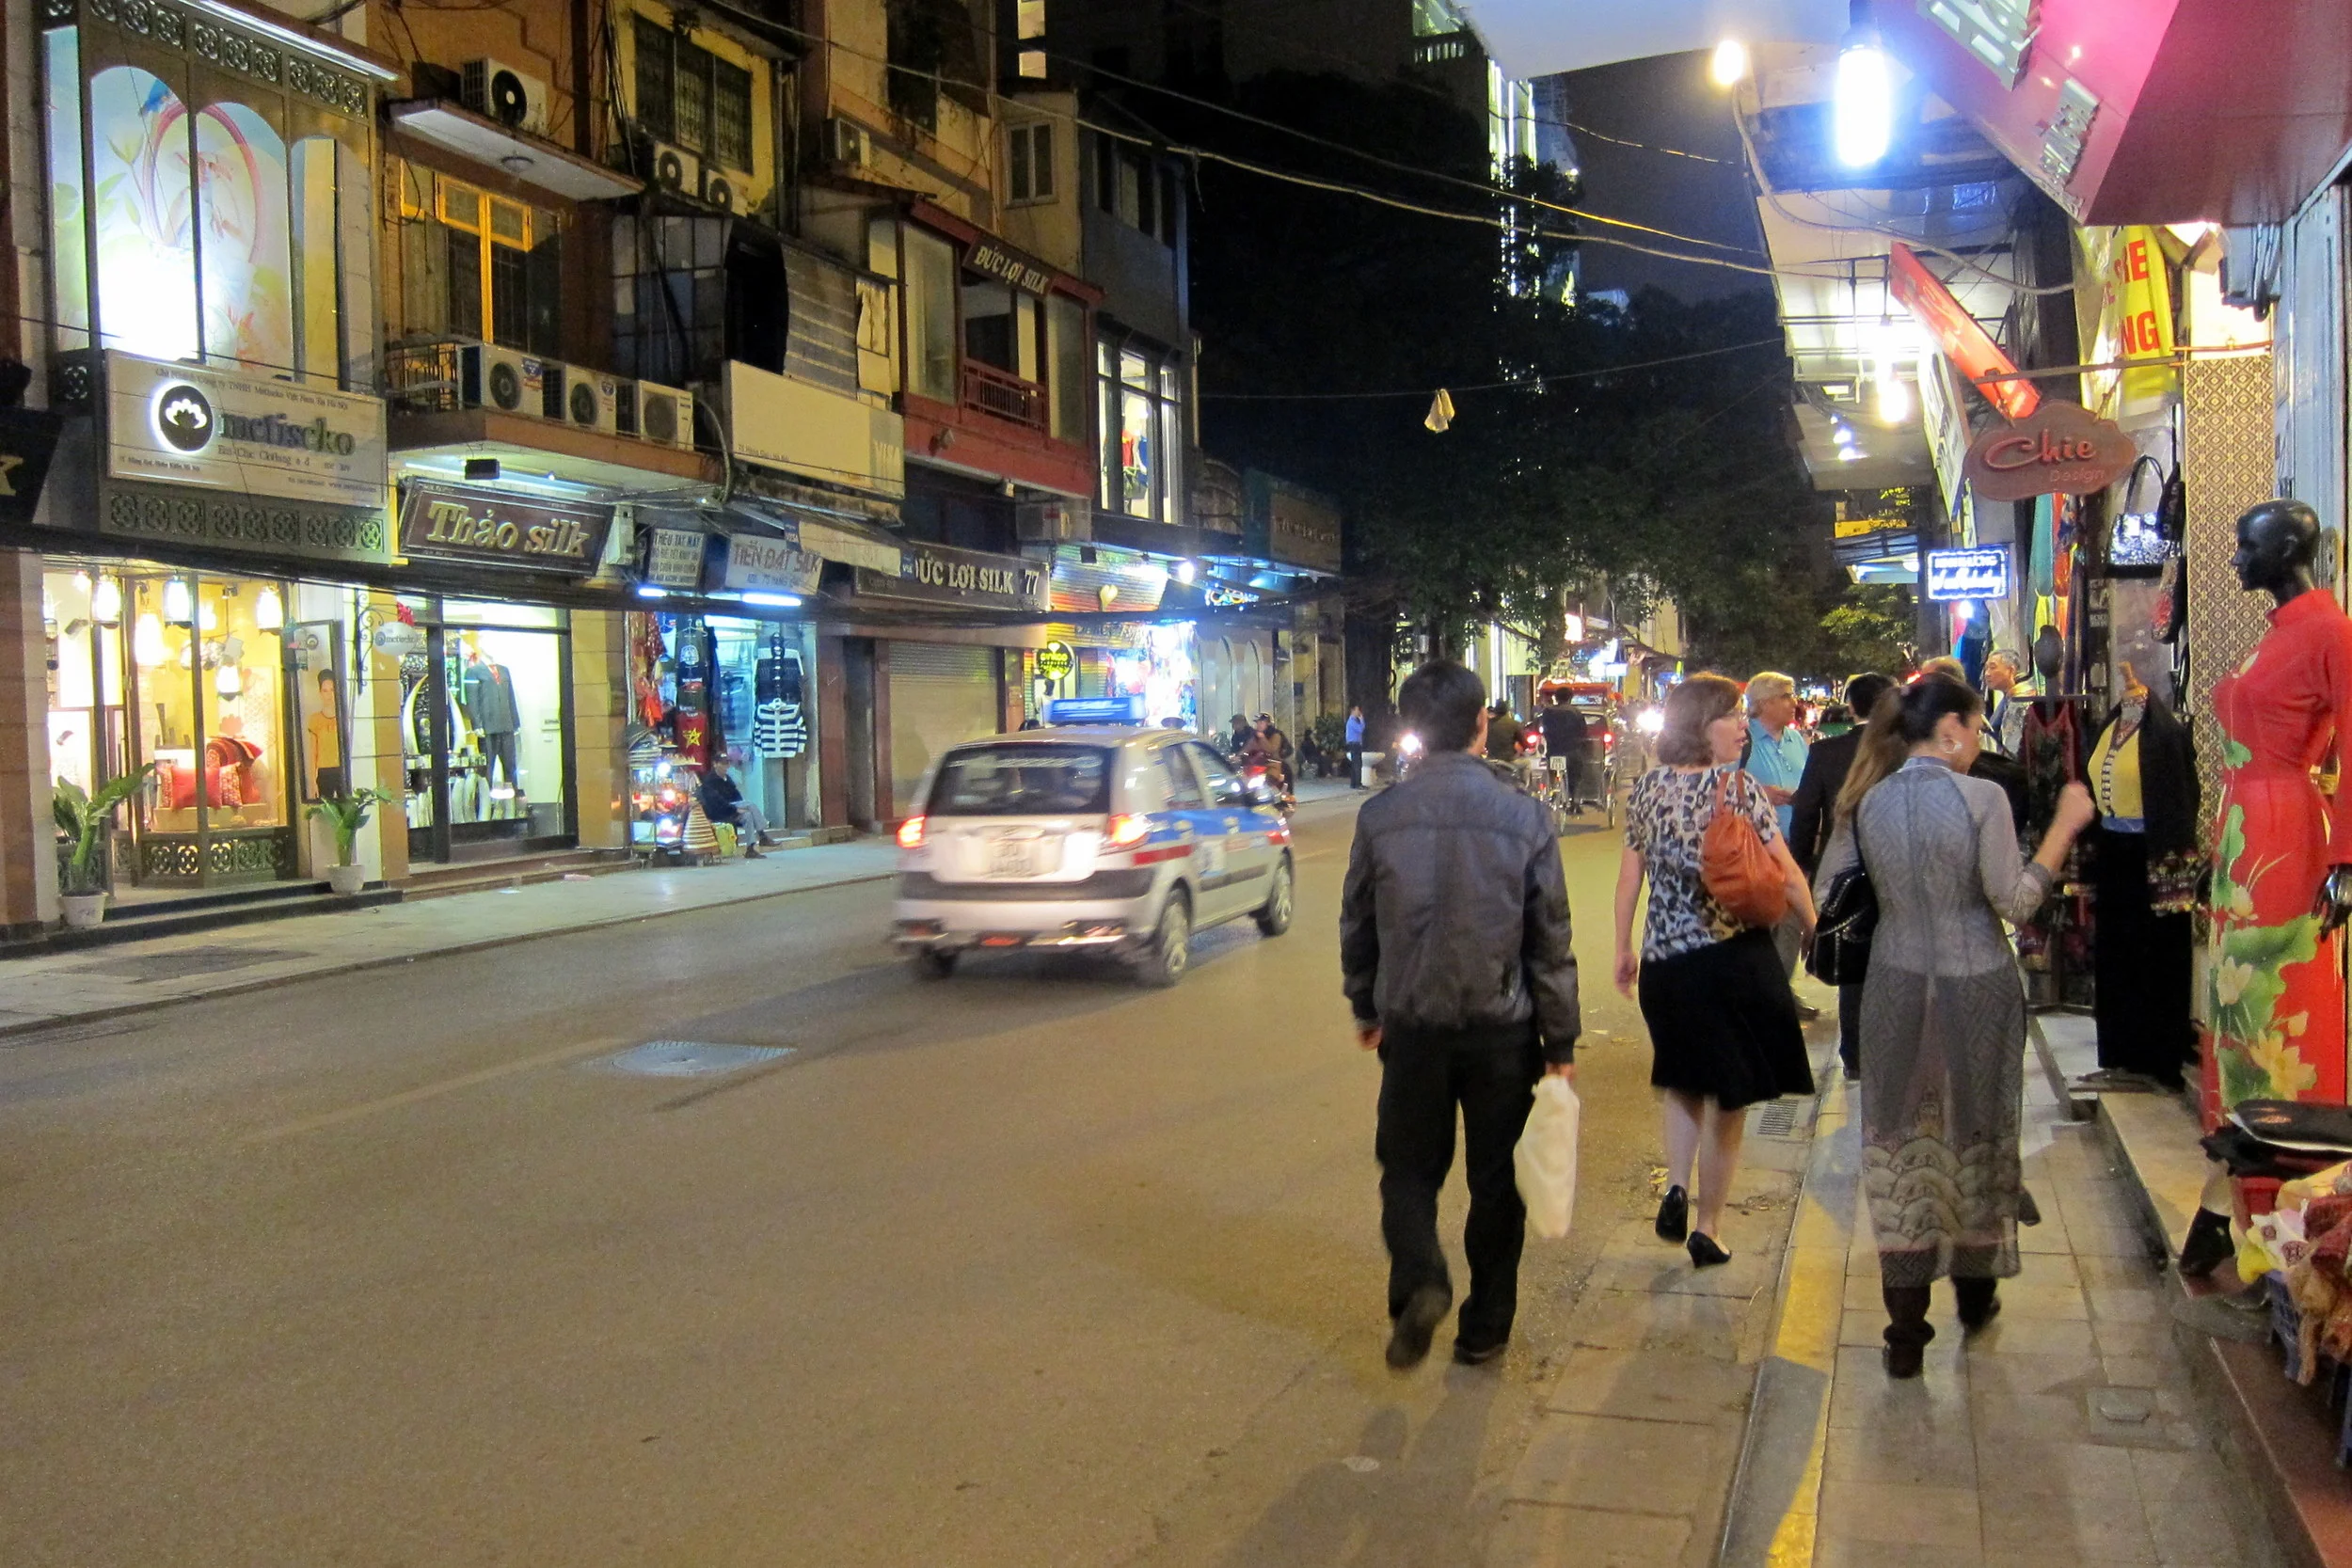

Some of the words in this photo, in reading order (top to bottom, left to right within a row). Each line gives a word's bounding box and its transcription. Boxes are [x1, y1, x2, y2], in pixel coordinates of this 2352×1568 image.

[1021, 268, 1050, 294] SILK
[1984, 428, 2097, 469] Chie
[2050, 467, 2106, 483] Design
[426, 499, 518, 550] Thảo
[524, 518, 591, 558] silk
[914, 549, 945, 586] ỨC
[948, 562, 976, 595] LỢI
[979, 567, 1014, 594] SILK
[1025, 569, 1040, 594] 77
